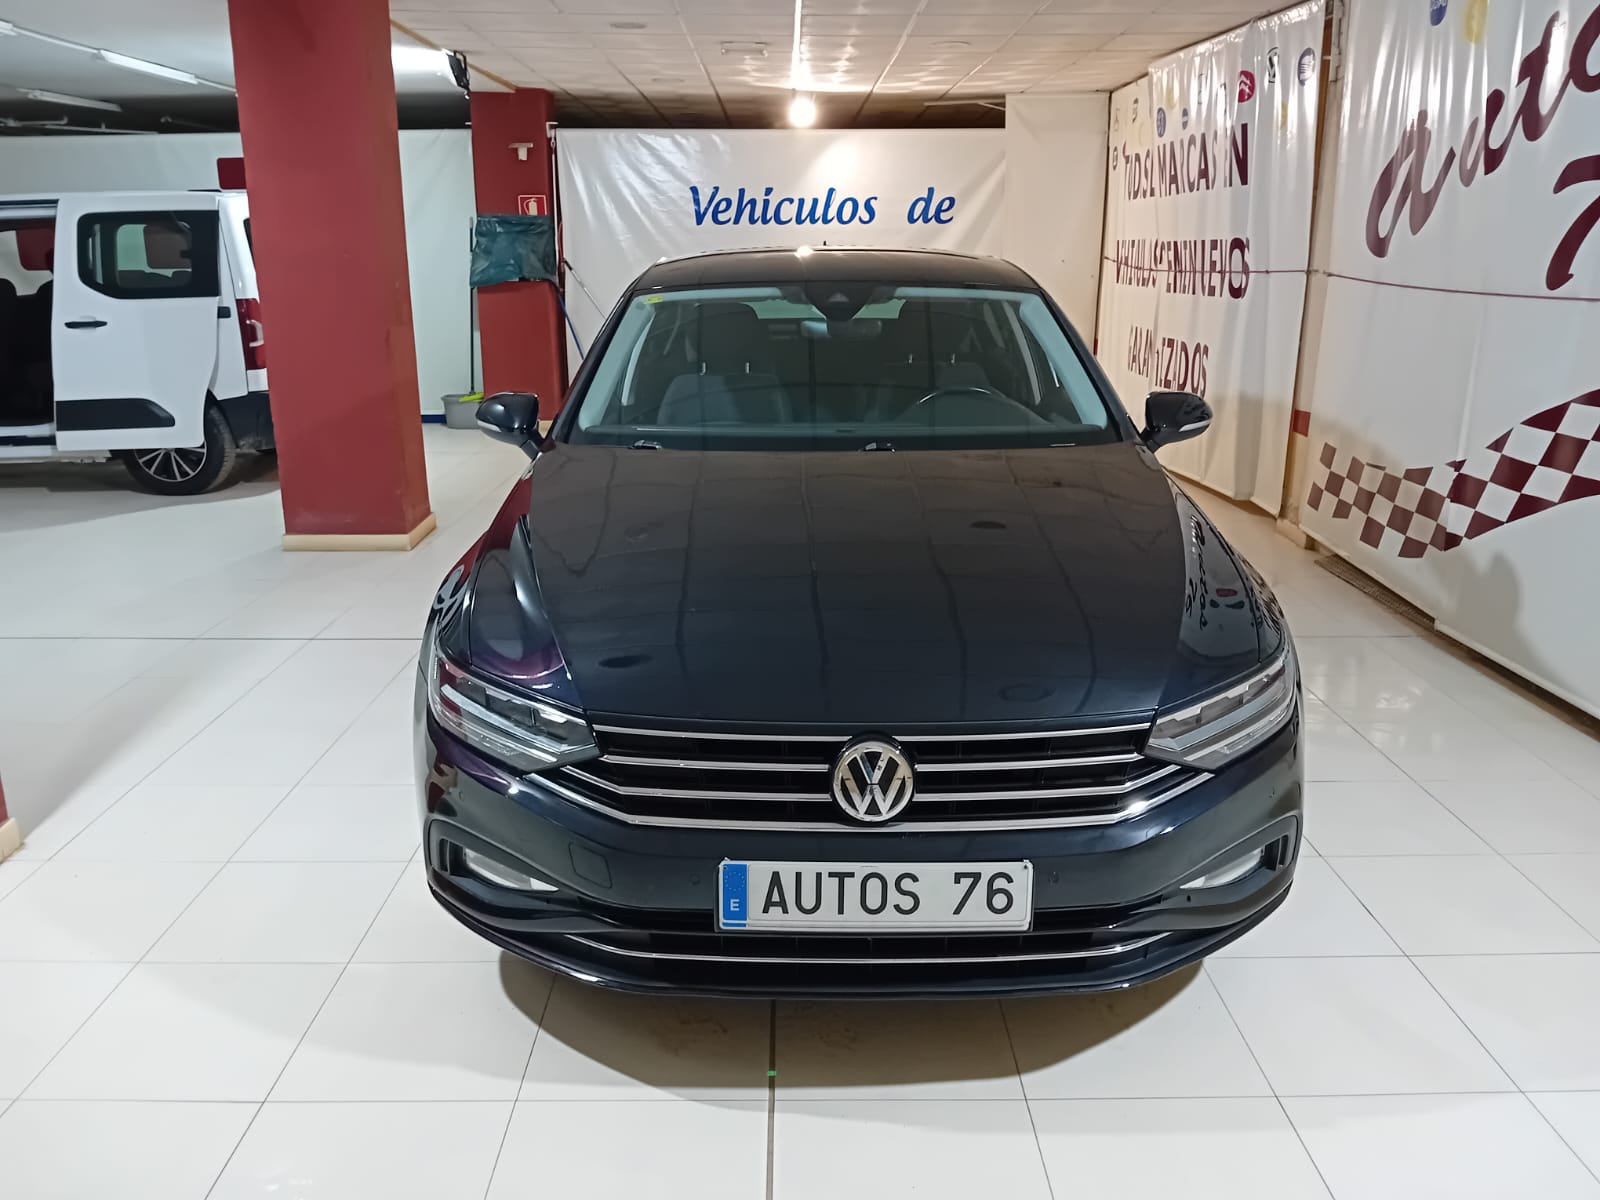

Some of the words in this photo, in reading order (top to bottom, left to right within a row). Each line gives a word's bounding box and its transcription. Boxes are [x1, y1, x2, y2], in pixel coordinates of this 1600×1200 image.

[907, 187, 956, 225] de
[730, 898, 740, 911] E
[762, 871, 920, 915] AUTOS
[952, 871, 1014, 915] 76
